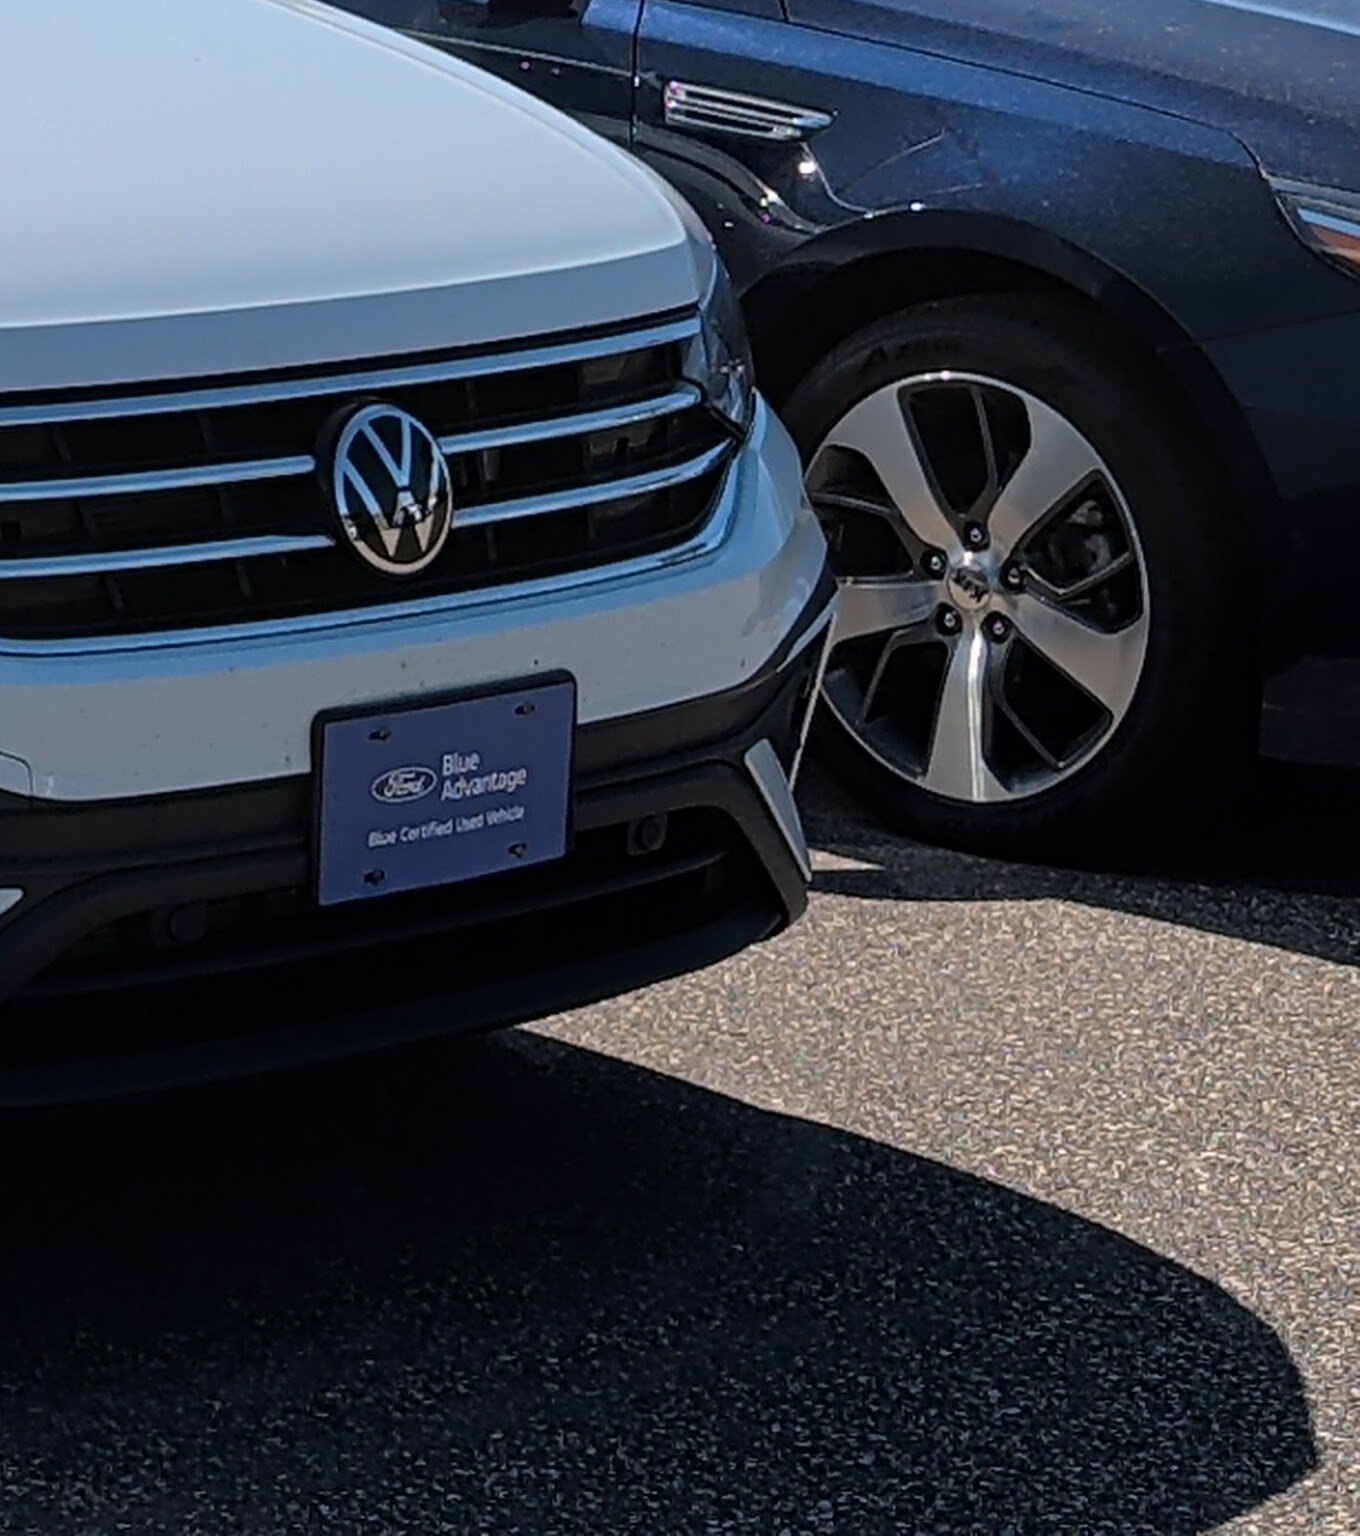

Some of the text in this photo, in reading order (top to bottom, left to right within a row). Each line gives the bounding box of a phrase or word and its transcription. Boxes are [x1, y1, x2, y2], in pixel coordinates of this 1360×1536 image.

[441, 751, 481, 777] Blue
[441, 767, 528, 802] Advantage
[368, 805, 526, 848] Blue Certified Used Vehicle
